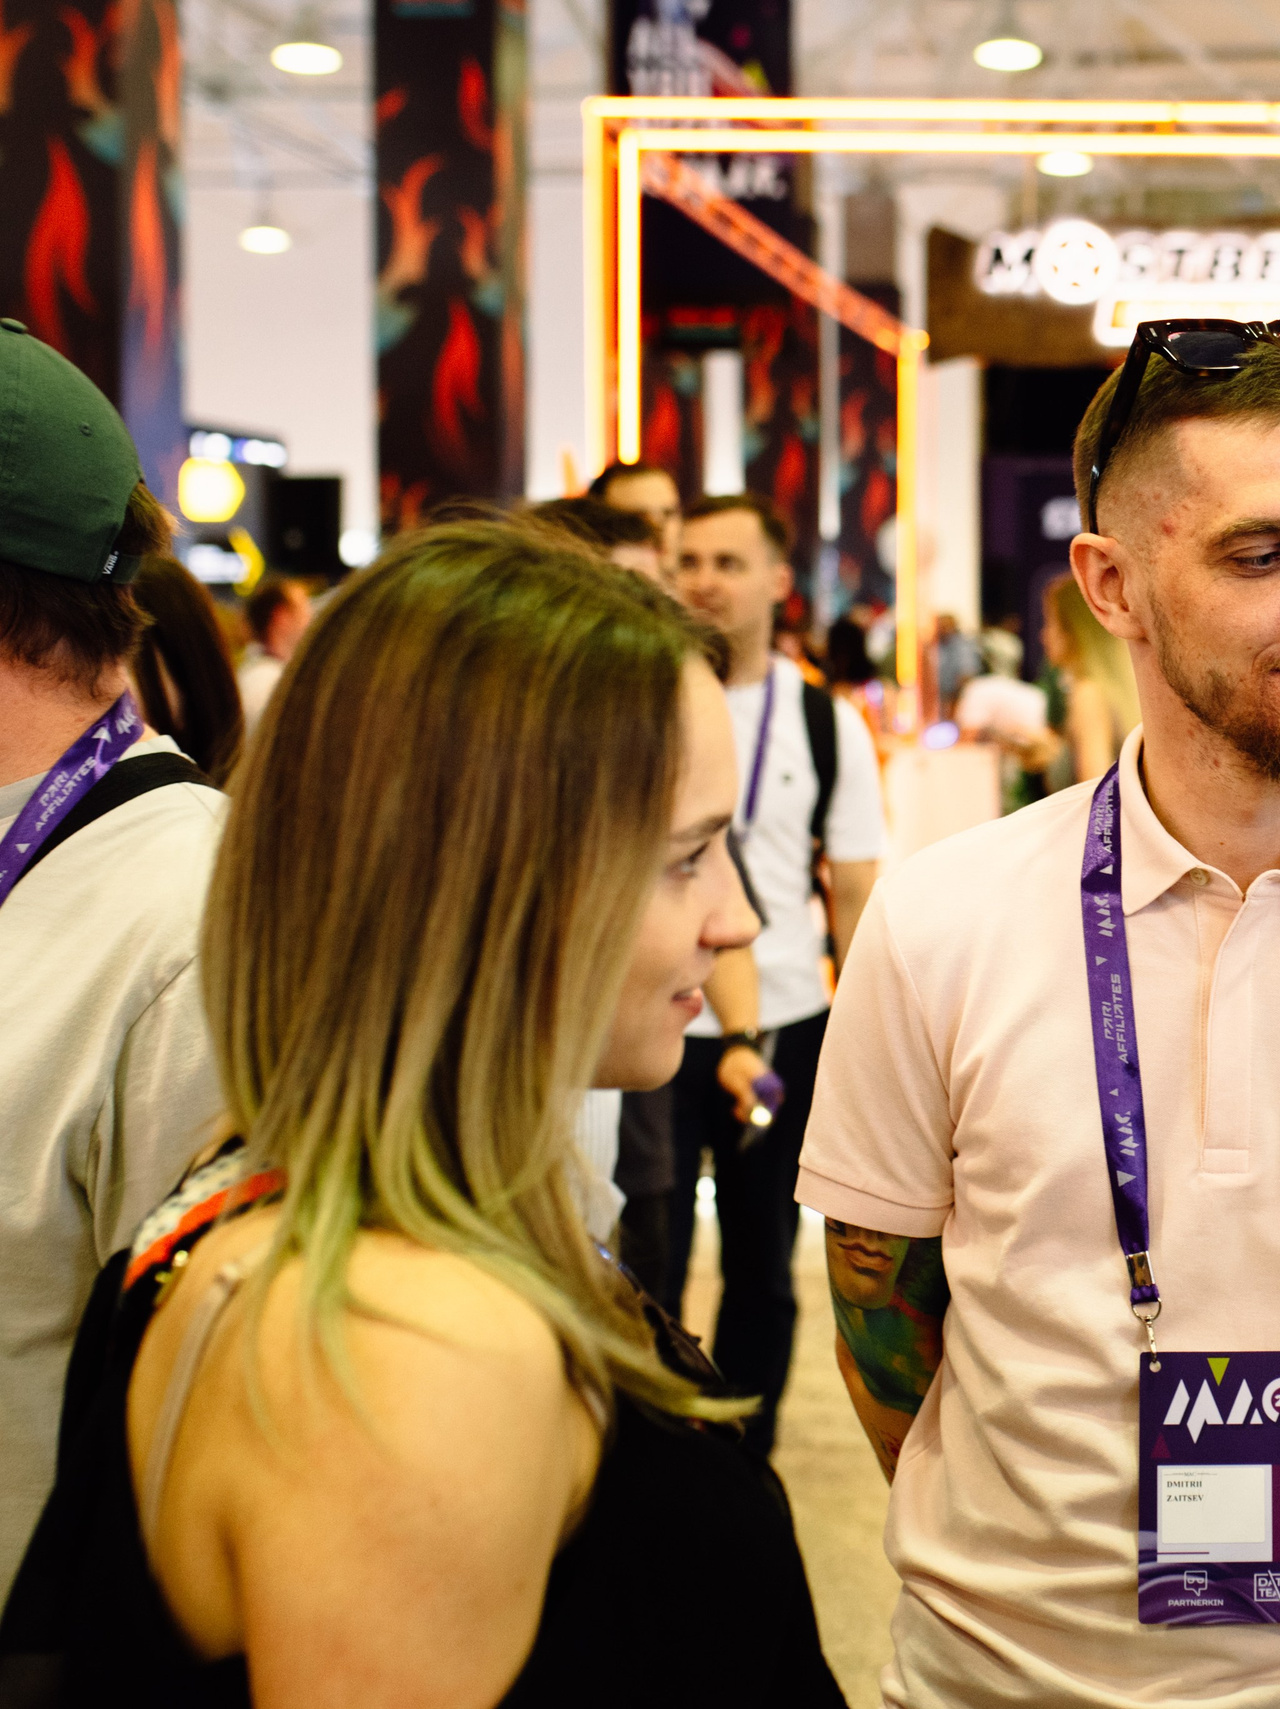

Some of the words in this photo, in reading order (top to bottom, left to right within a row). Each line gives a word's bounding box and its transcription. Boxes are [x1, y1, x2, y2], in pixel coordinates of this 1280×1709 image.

[35, 756, 98, 832] AFFILIATES
[39, 770, 70, 806] PARI
[1101, 1000, 1115, 1040] PARI
[1110, 973, 1130, 1064] AFFILIATES
[1166, 1494, 1205, 1503] ZAITSEV
[1167, 1598, 1224, 1608] PARTNERKIN
